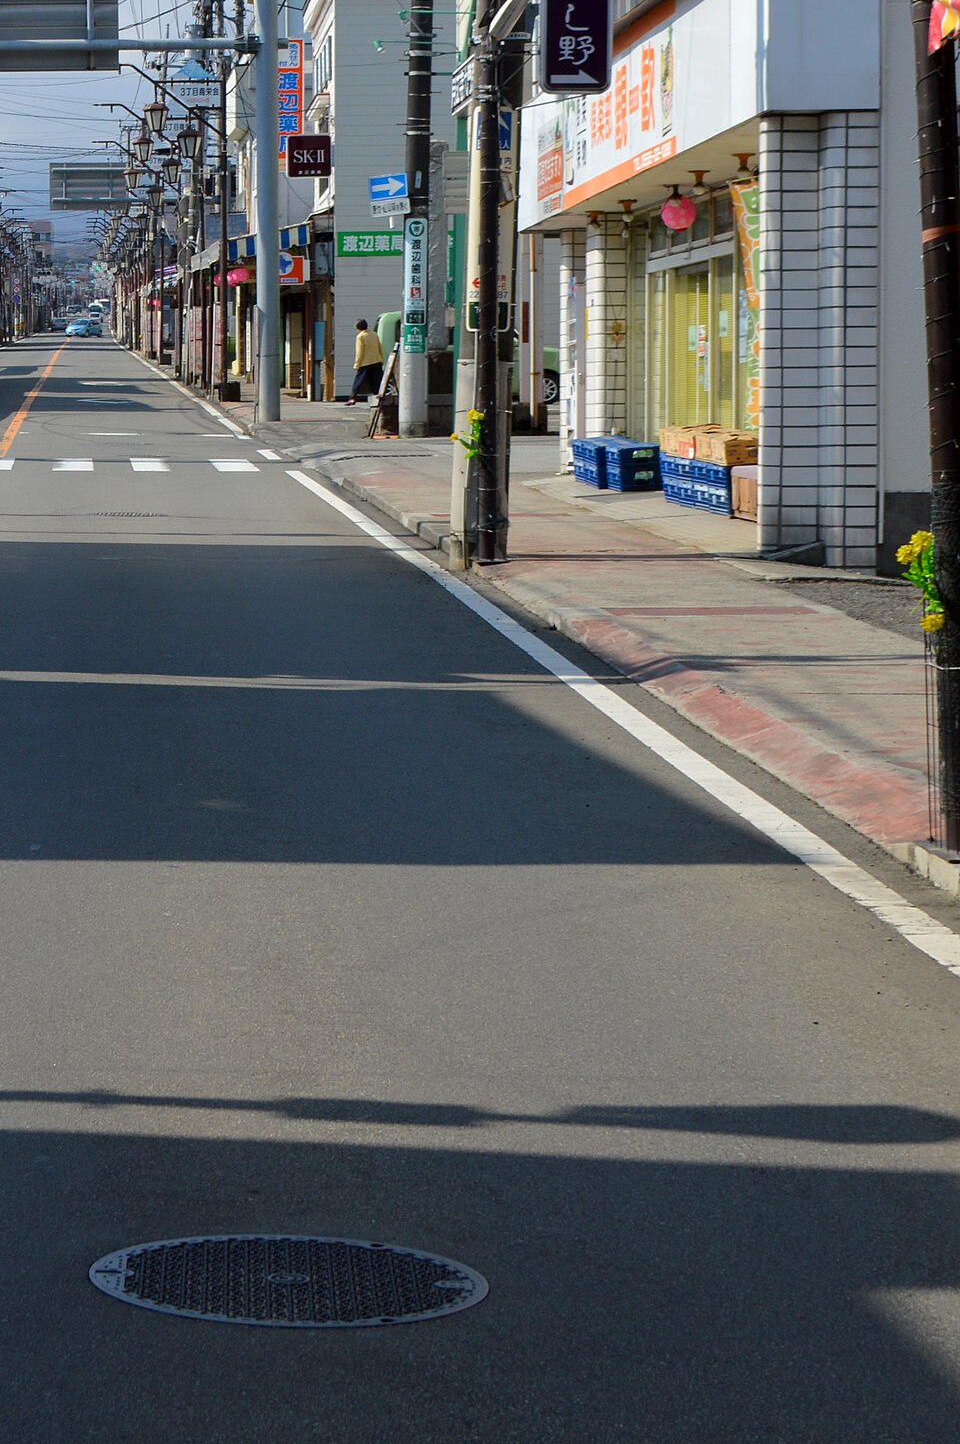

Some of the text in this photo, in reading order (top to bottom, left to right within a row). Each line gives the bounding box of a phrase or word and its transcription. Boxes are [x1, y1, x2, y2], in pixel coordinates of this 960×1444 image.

[180, 87, 220, 96] 3丁目商栄会
[293, 149, 325, 164] SK-II
